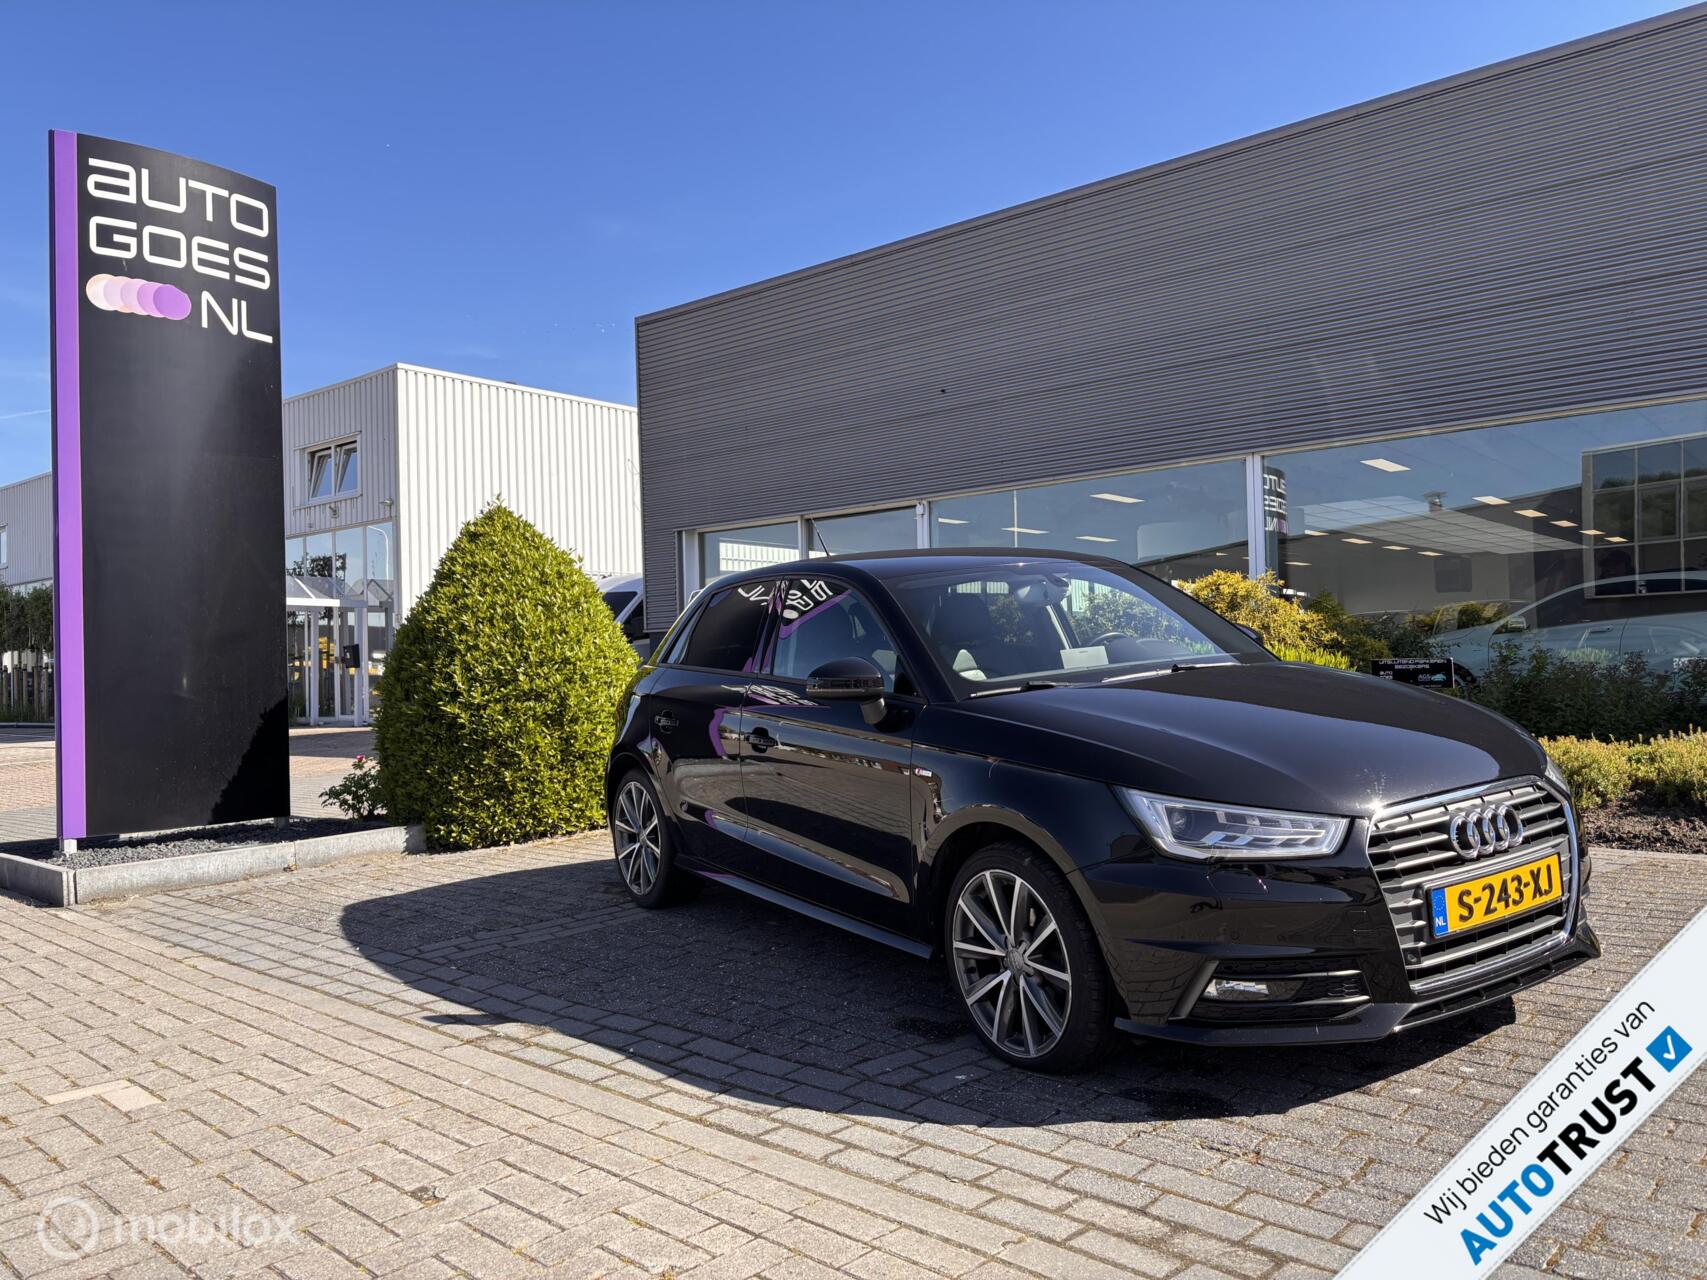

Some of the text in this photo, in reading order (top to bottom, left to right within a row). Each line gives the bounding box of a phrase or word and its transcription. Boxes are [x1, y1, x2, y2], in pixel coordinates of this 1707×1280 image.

[89, 216, 271, 290] GOES
[201, 291, 273, 343] NL
[1457, 863, 1554, 923] S-243-XJ
[1435, 916, 1447, 927] NL
